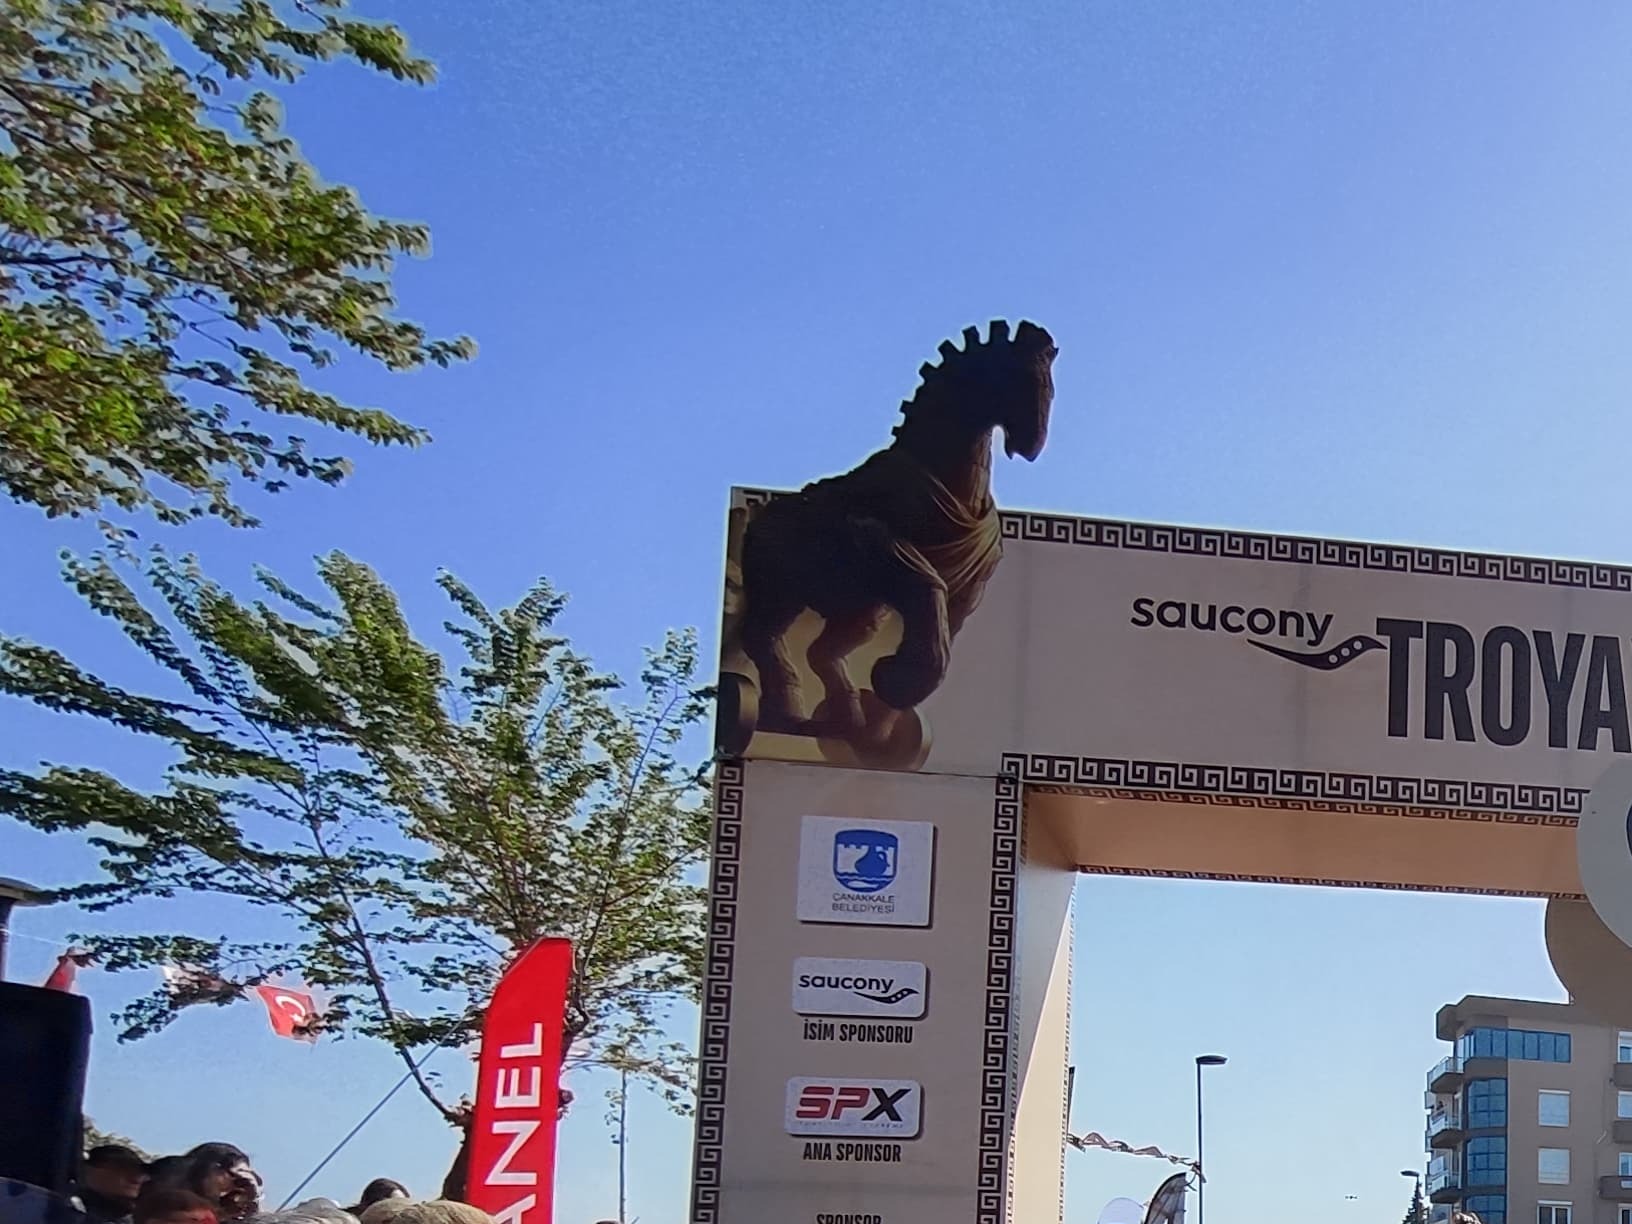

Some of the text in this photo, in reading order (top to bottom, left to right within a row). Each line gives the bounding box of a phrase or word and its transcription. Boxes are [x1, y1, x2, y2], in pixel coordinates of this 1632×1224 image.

[1131, 598, 1333, 647] saucony
[800, 974, 894, 994] saucony
[803, 1018, 913, 1044] İSİM SPONSORU
[795, 1086, 911, 1121] SPX
[803, 1143, 902, 1163] ANA SPONSOR
